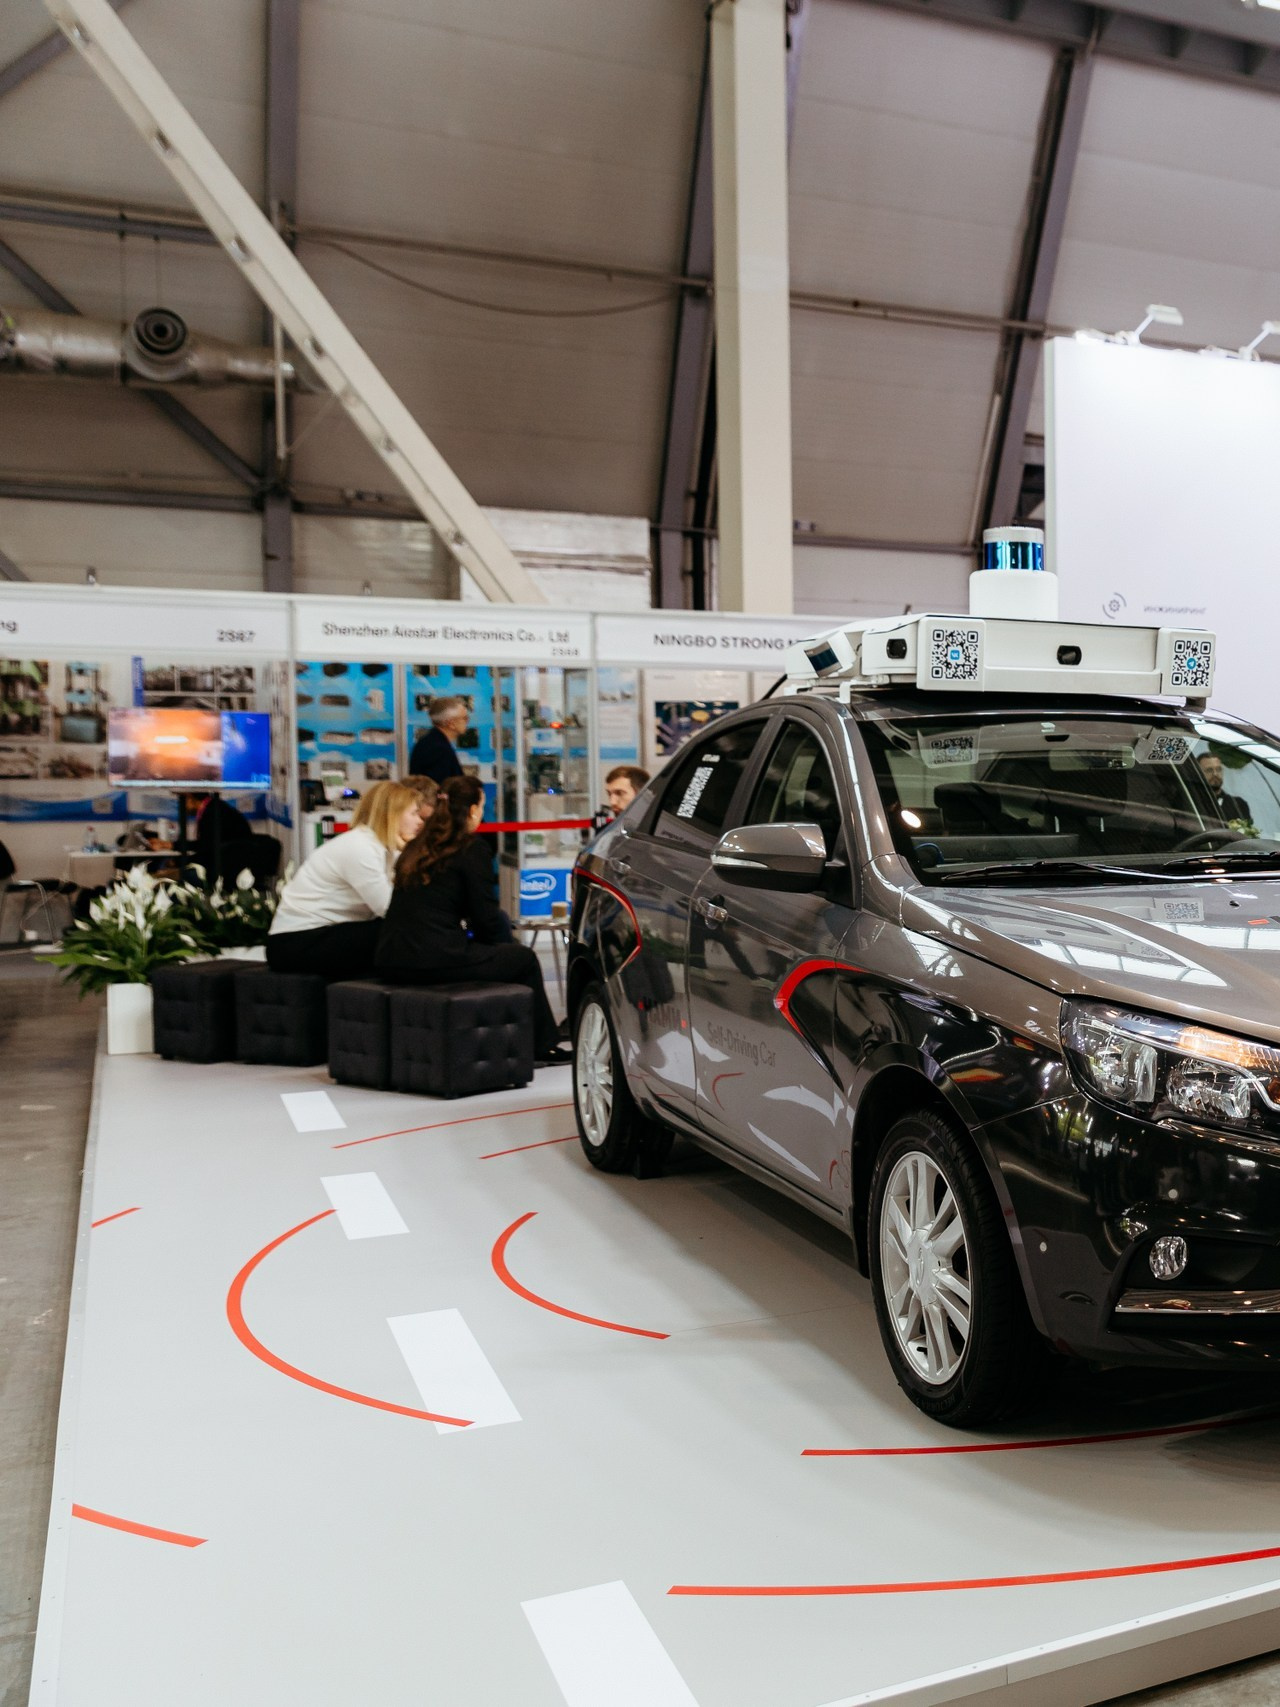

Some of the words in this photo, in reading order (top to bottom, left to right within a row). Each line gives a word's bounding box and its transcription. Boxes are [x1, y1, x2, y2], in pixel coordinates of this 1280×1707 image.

[323, 622, 389, 637] Shenzhen
[442, 626, 513, 641] Electronics
[548, 629, 570, 643] Ltd
[654, 634, 717, 648] NINGBO
[721, 636, 785, 650] STRONG
[707, 1021, 759, 1067] Self-Driving
[760, 1041, 776, 1067] Car
